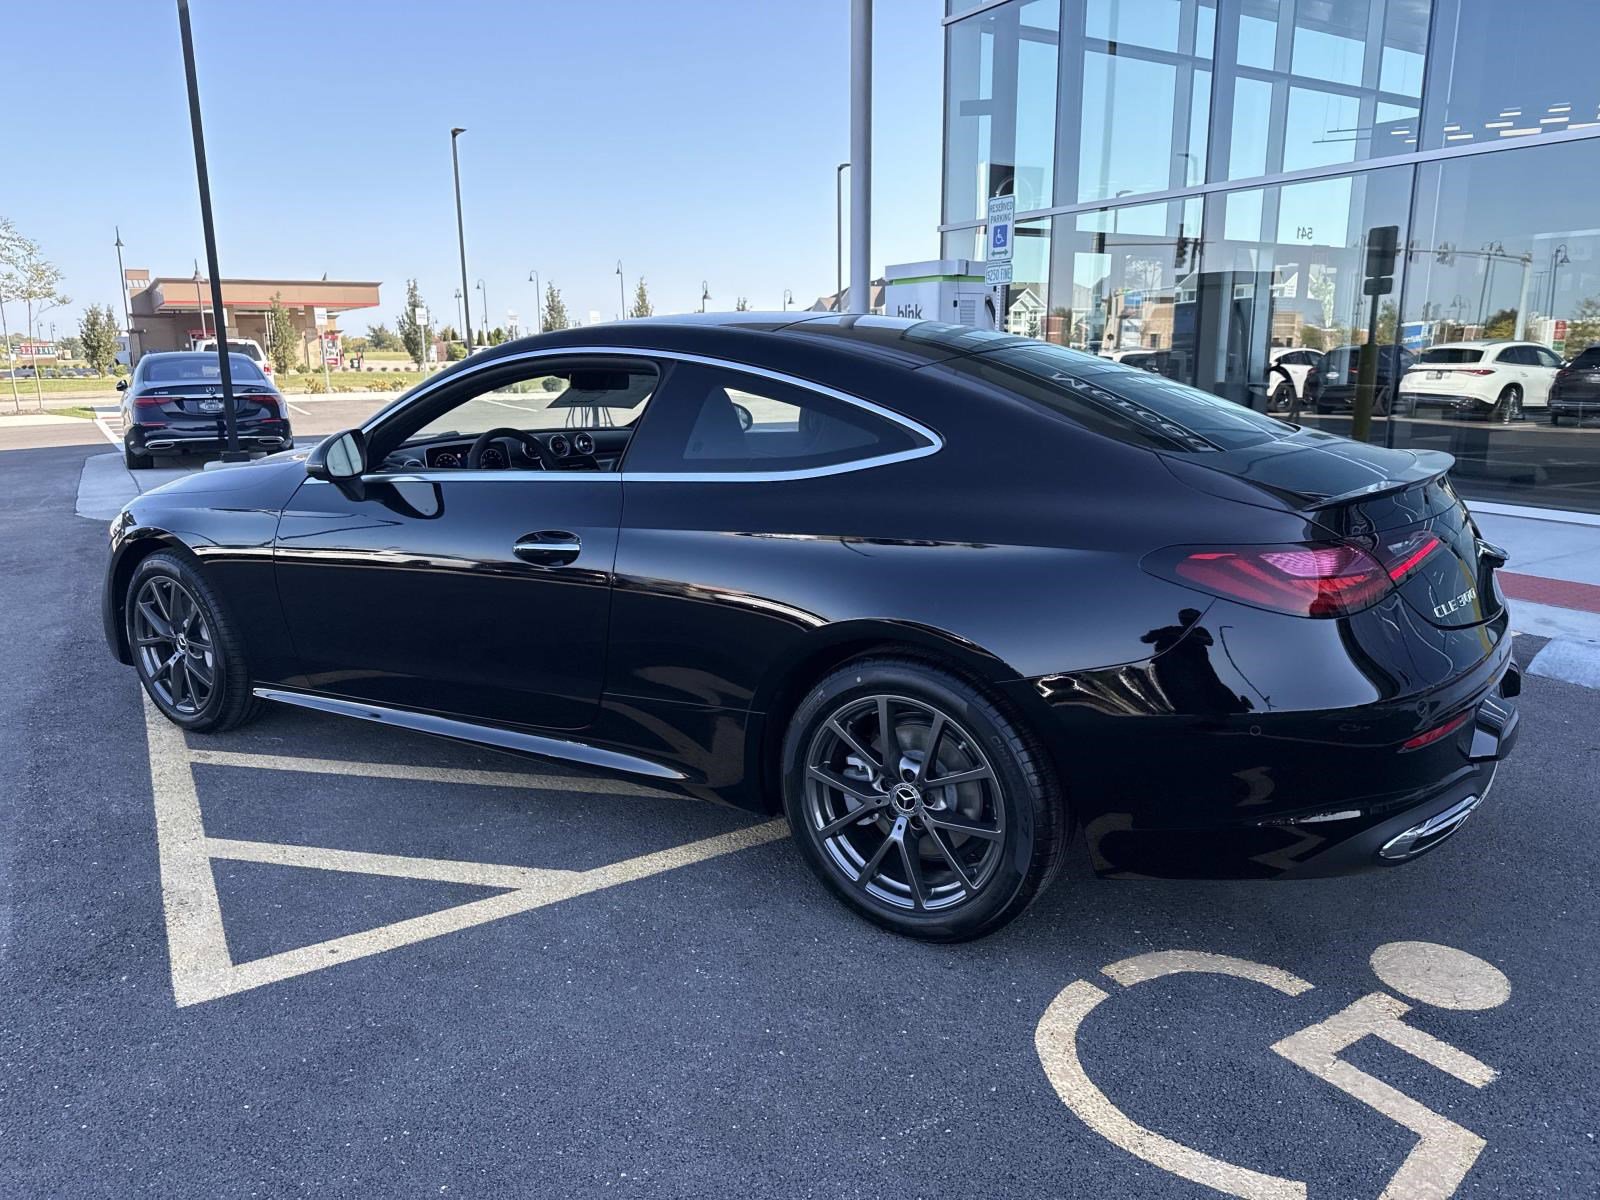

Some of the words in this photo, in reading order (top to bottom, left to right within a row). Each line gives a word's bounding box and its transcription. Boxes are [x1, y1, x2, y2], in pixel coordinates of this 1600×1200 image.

[989, 201, 1014, 213] RESERVED
[990, 213, 1012, 225] PARKING
[1000, 267, 1012, 281] FINE
[897, 303, 923, 320] blink
[1433, 599, 1459, 618] CLE
[1456, 587, 1477, 607] 300
